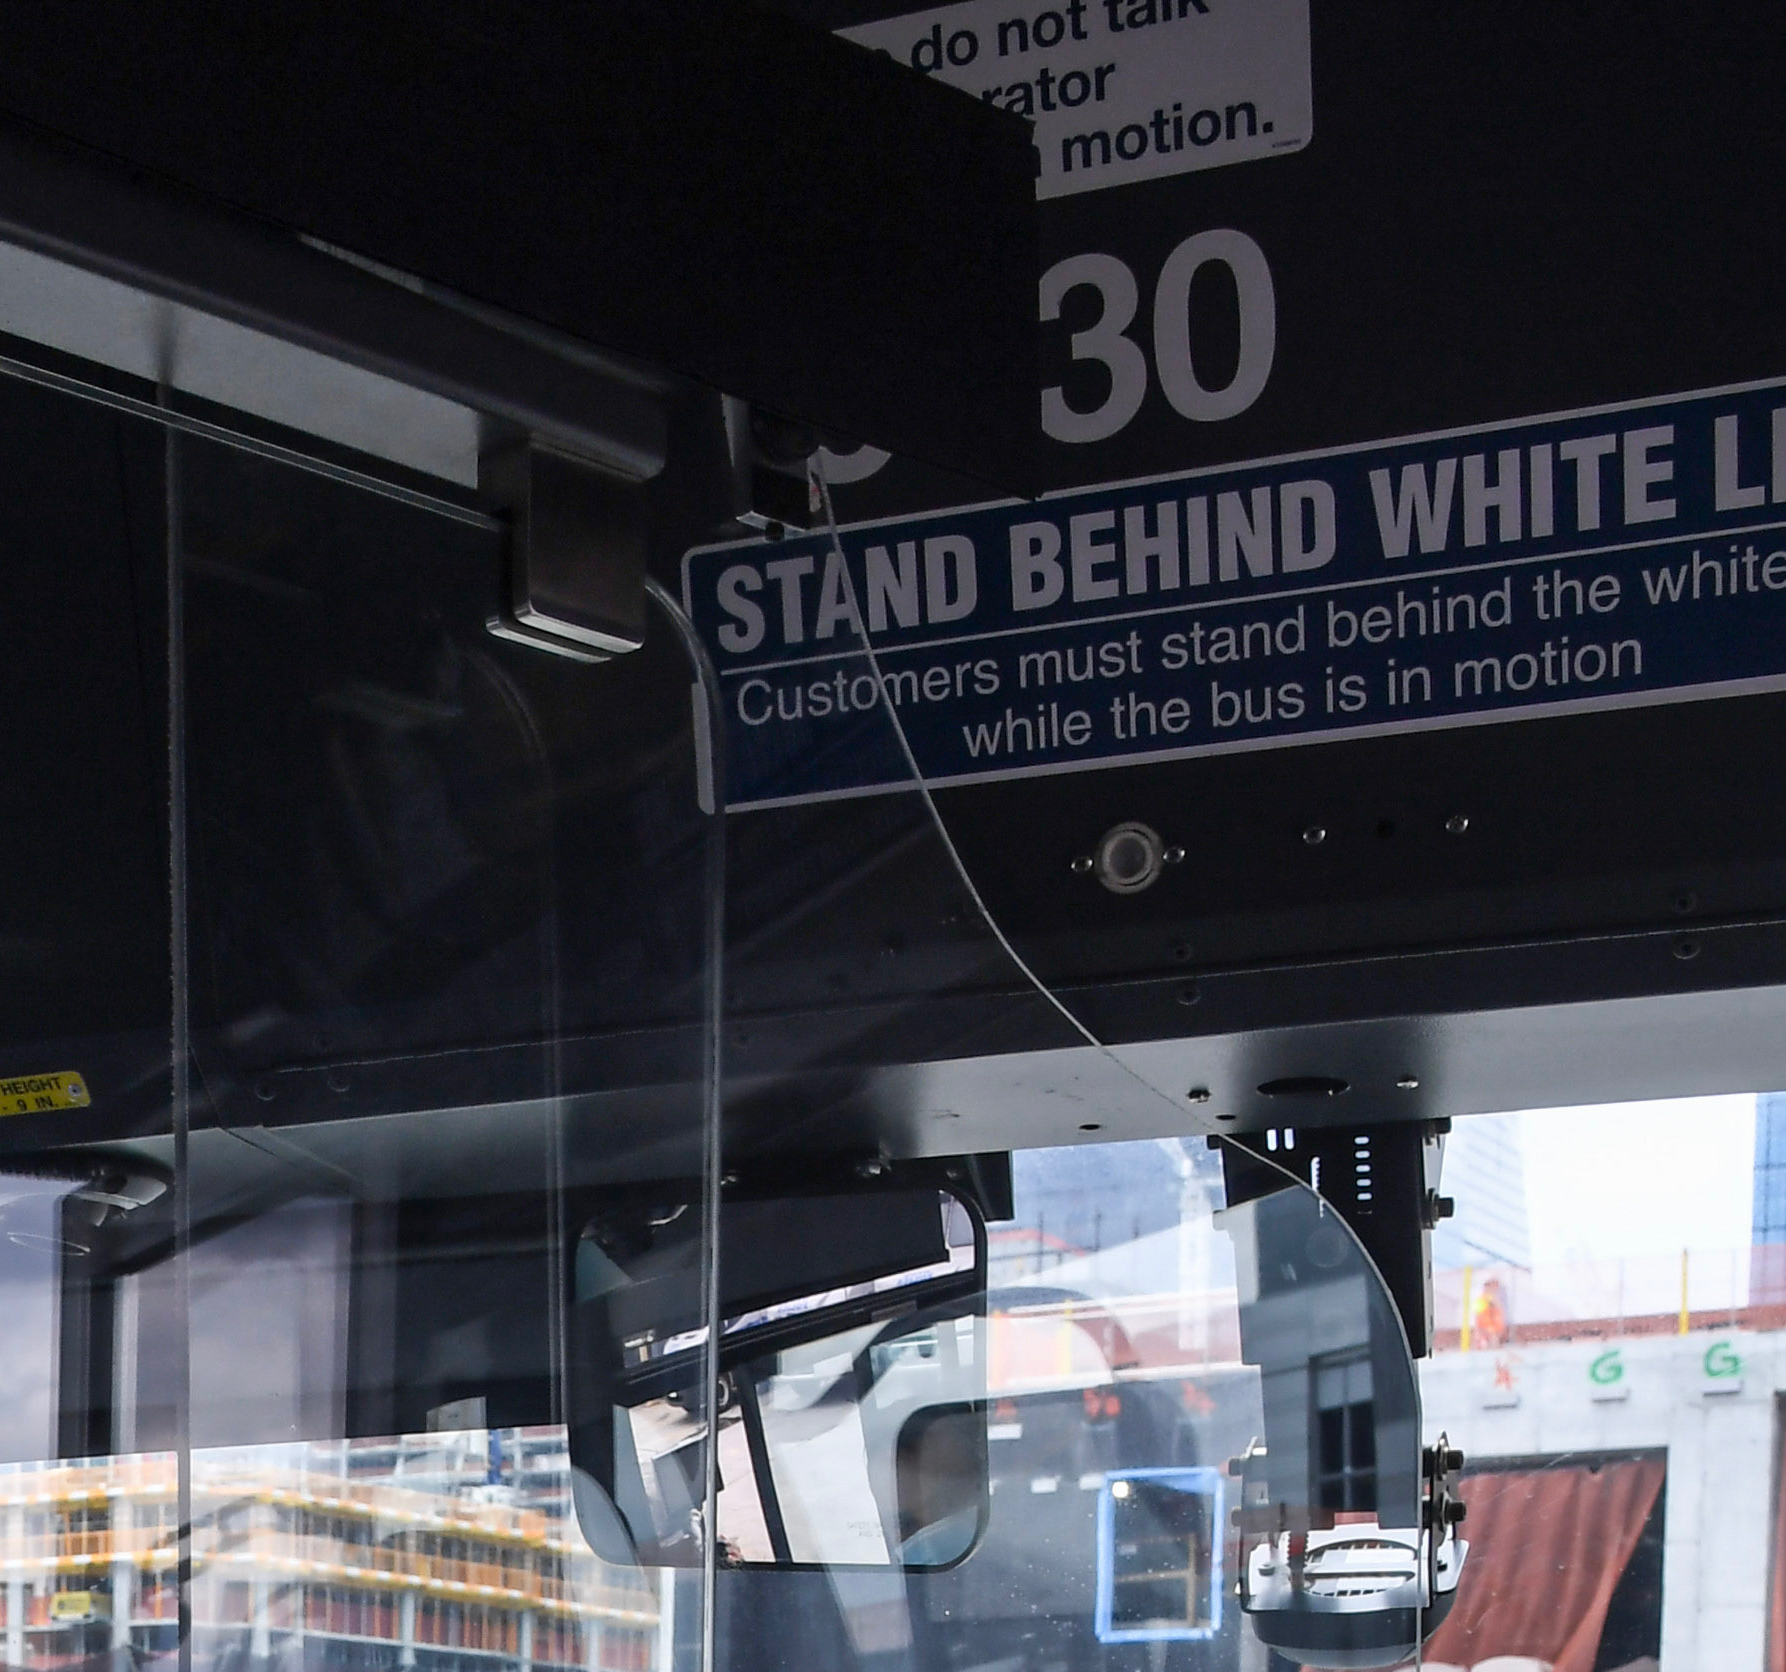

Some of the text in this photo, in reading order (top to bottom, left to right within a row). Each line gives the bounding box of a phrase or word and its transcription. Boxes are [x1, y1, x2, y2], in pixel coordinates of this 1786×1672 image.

[910, 26, 980, 74] do
[997, 0, 1089, 57] not
[1061, 99, 1275, 172] motion.
[715, 532, 978, 656] STAND
[1009, 477, 1338, 612] BEHIND
[1370, 424, 1678, 556] WHITE
[734, 543, 1786, 729] Customers must stand behind the white
[962, 635, 1644, 760] while the bus is in motion
[0, 1075, 64, 1098] HEIGHT
[16, 1099, 27, 1112] 9
[34, 1094, 59, 1109] IN.
